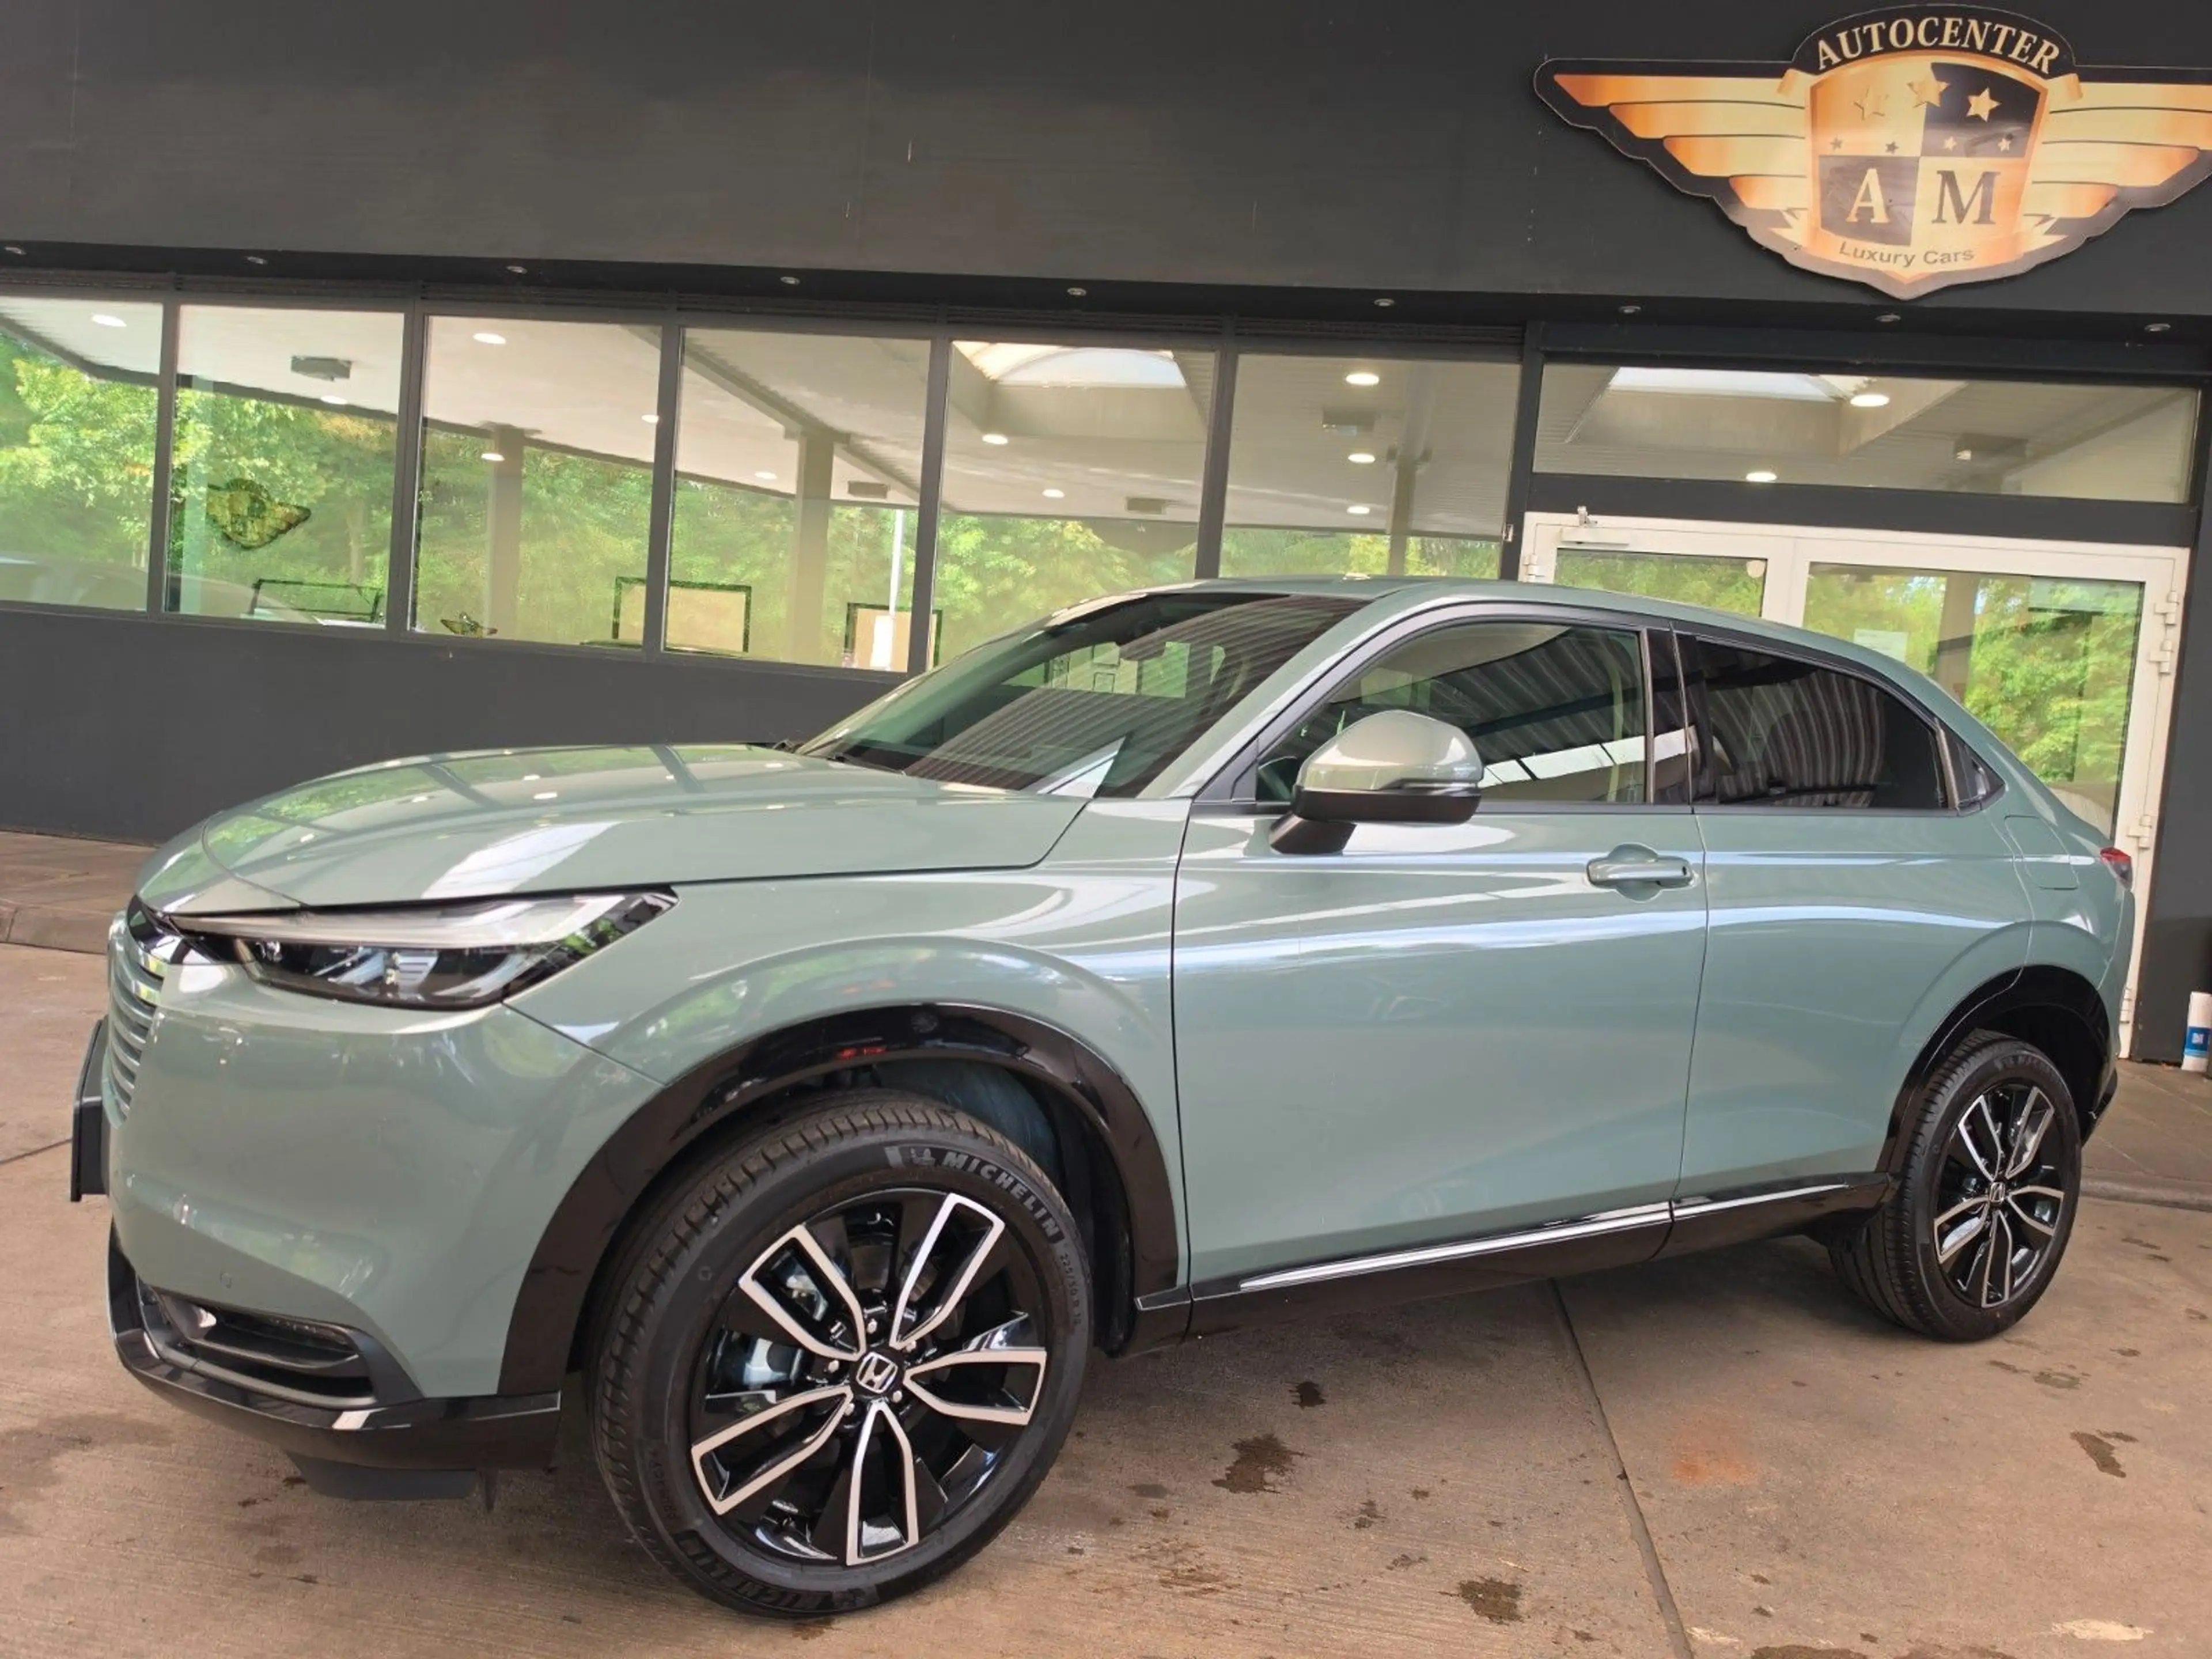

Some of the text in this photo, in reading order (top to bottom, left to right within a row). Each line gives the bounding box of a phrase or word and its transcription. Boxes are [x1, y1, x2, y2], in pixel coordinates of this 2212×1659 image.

[1819, 17, 2059, 74] AUTOCENTER
[1846, 168, 2001, 225] A M
[1839, 241, 1975, 268] Luxury Cars
[941, 1152, 1060, 1237] MICHELIN
